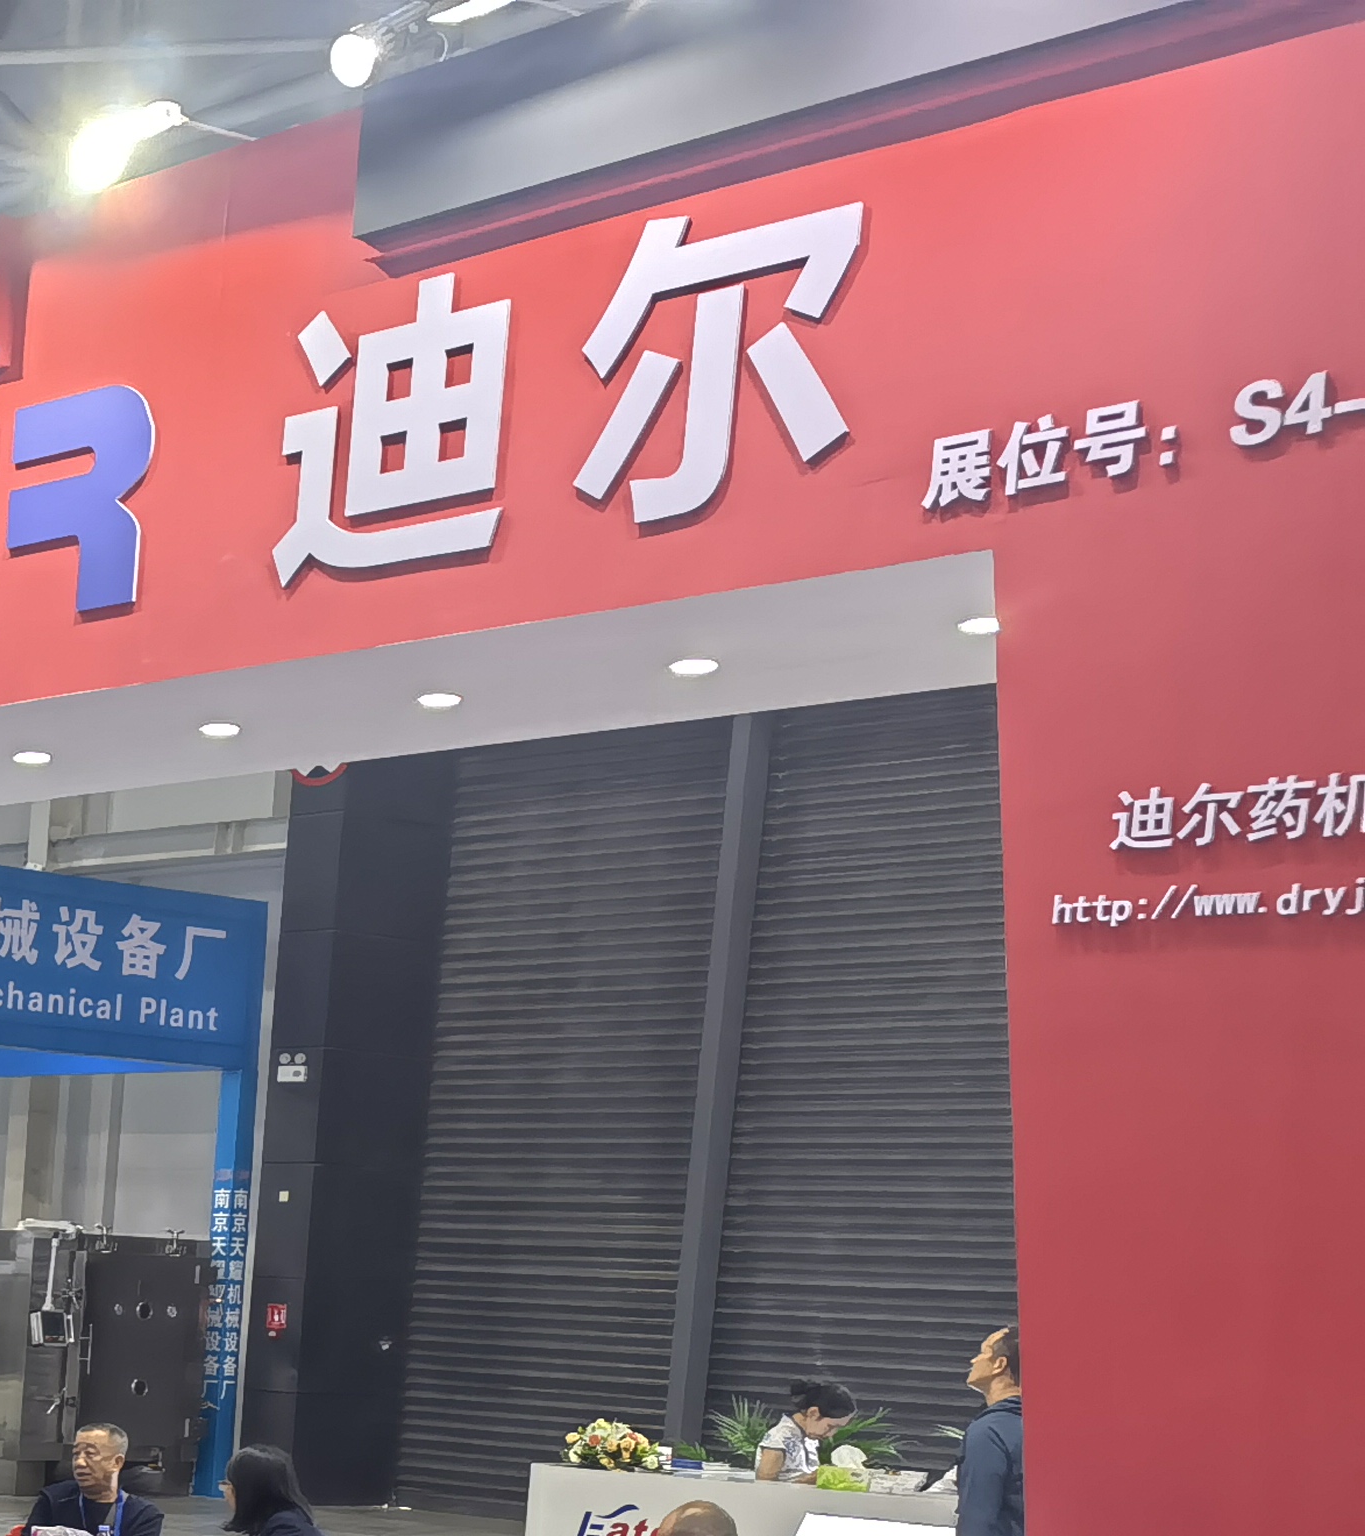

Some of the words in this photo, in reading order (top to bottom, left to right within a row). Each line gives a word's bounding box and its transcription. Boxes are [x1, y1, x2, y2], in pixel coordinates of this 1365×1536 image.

[271, 202, 864, 588] 迪尔
[1109, 772, 1365, 851] 迪尔药机
[139, 997, 219, 1031] Plant
